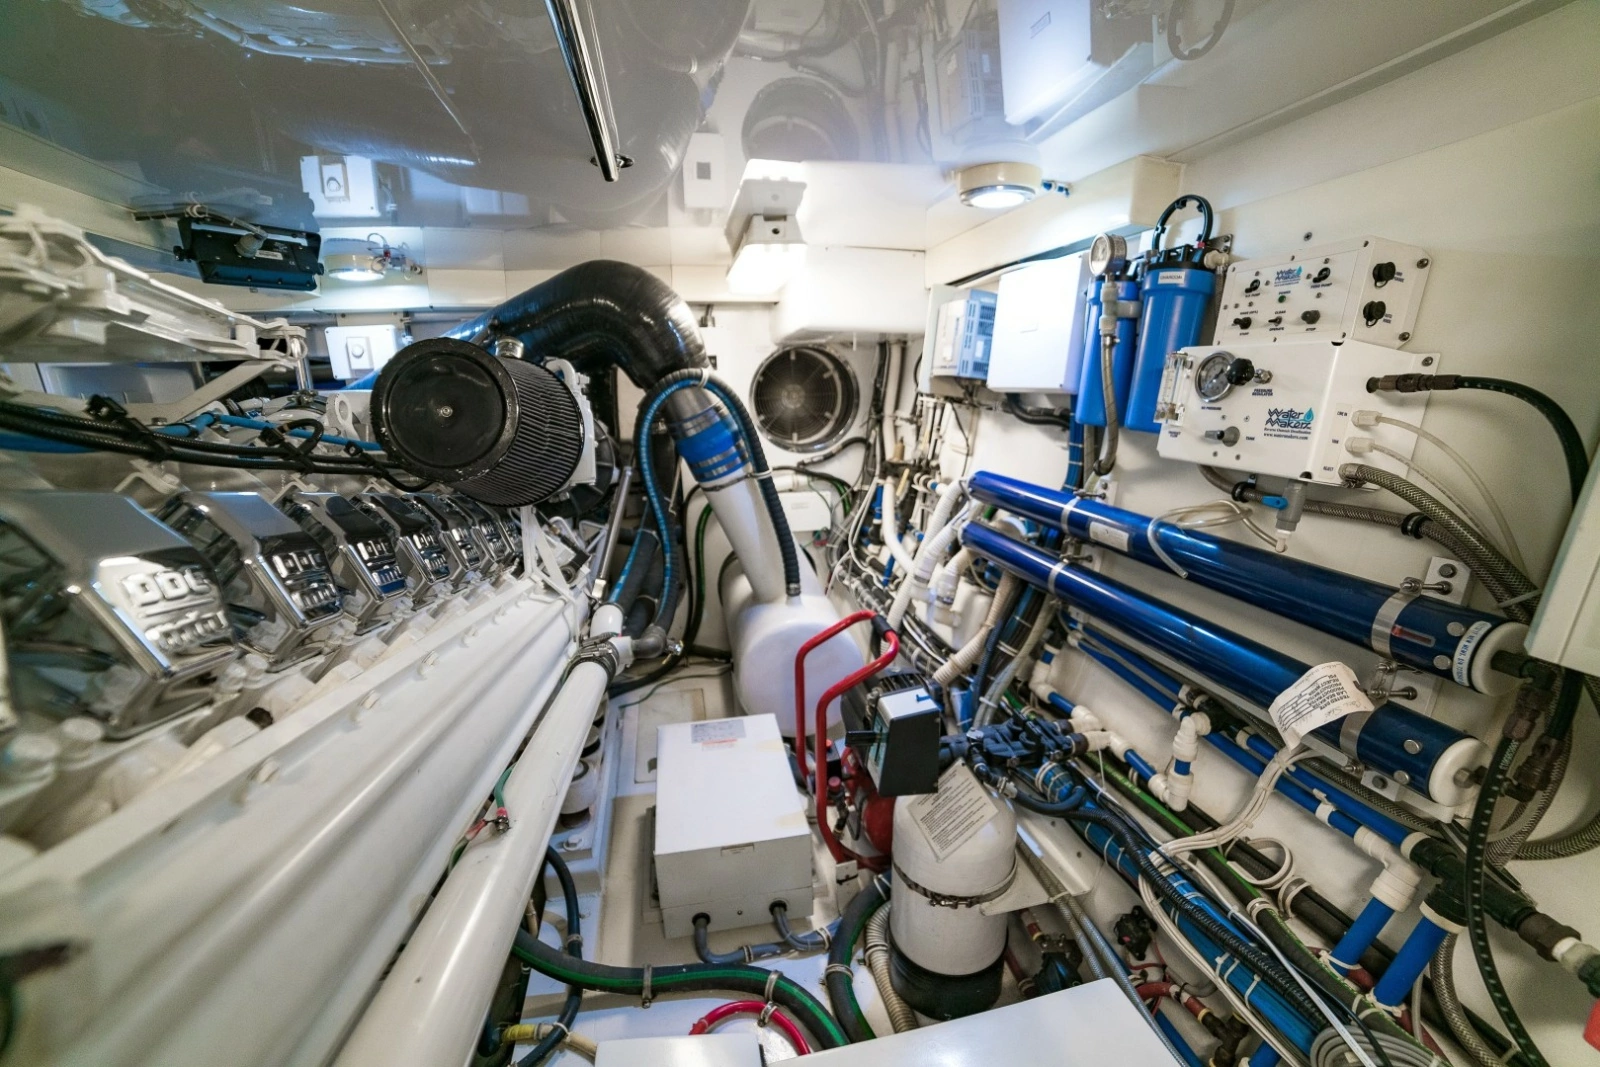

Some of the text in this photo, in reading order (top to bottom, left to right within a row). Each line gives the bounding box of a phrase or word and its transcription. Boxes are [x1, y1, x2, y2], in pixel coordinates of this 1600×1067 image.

[1268, 408, 1304, 420] Water
[122, 568, 212, 606] DDC
[1320, 682, 1341, 693] PRODUCT
[1321, 678, 1339, 688] REJECT
[1322, 686, 1344, 698] PRODUCT
[1331, 695, 1349, 703] TESTED
